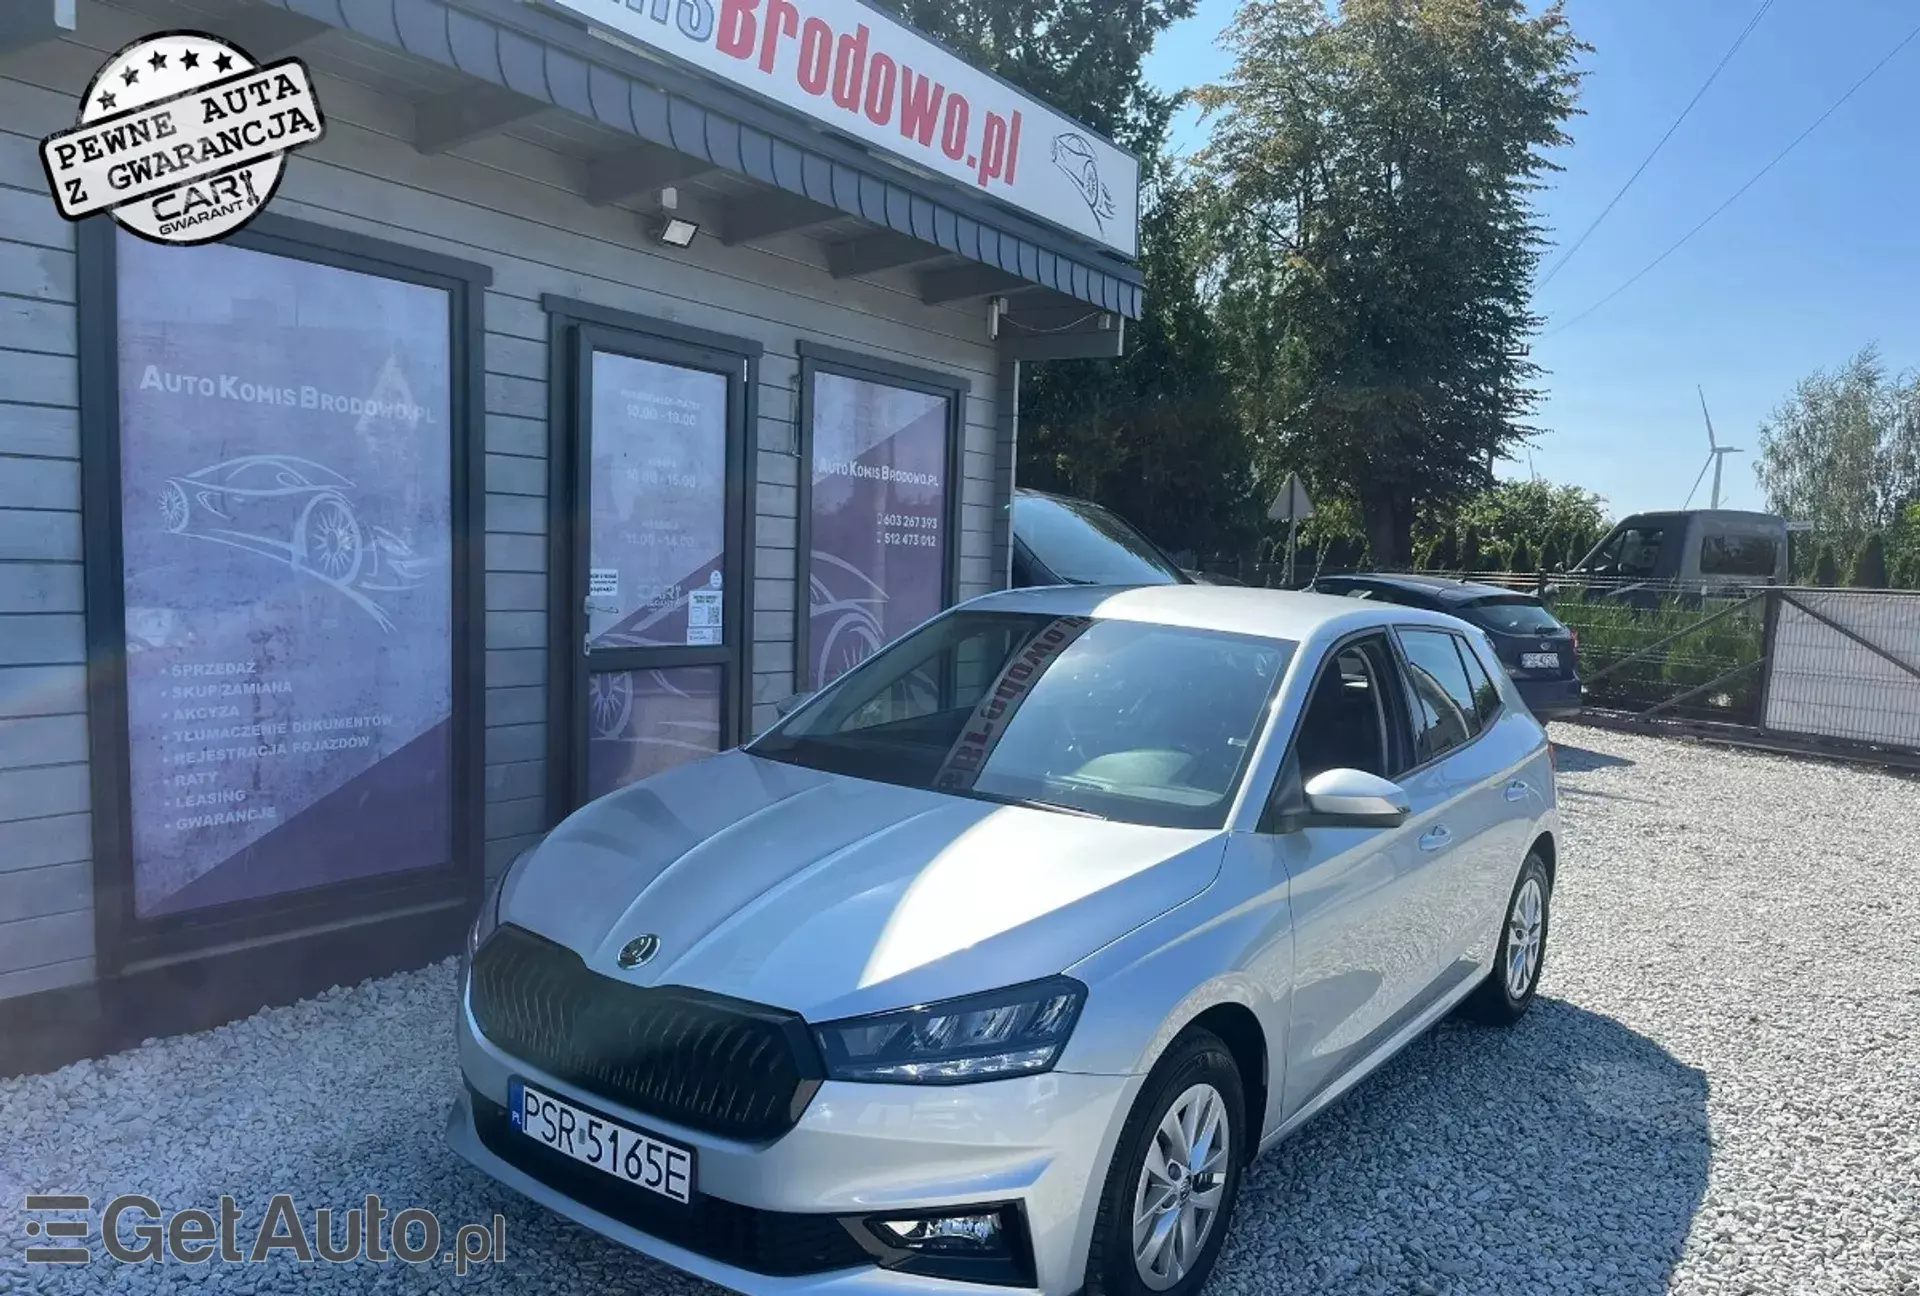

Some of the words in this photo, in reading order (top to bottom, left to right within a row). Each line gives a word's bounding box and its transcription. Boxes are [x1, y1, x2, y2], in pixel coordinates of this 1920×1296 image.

[883, 513, 902, 527] 603
[903, 515, 919, 528] 267
[884, 532, 900, 545] 512
[902, 533, 919, 546] 473
[173, 705, 240, 721] AKCYZA
[173, 722, 287, 743] TŁUMACZENIE
[292, 713, 394, 734] DOKUMENTÓW
[173, 746, 287, 766] REJESTRACJA
[174, 771, 219, 787] RATY
[176, 789, 246, 808] LEASING
[176, 806, 277, 831] GWARANCJE
[511, 1110, 522, 1125] PL
[524, 1091, 576, 1155] PSR
[587, 1119, 686, 1200] 5165E
